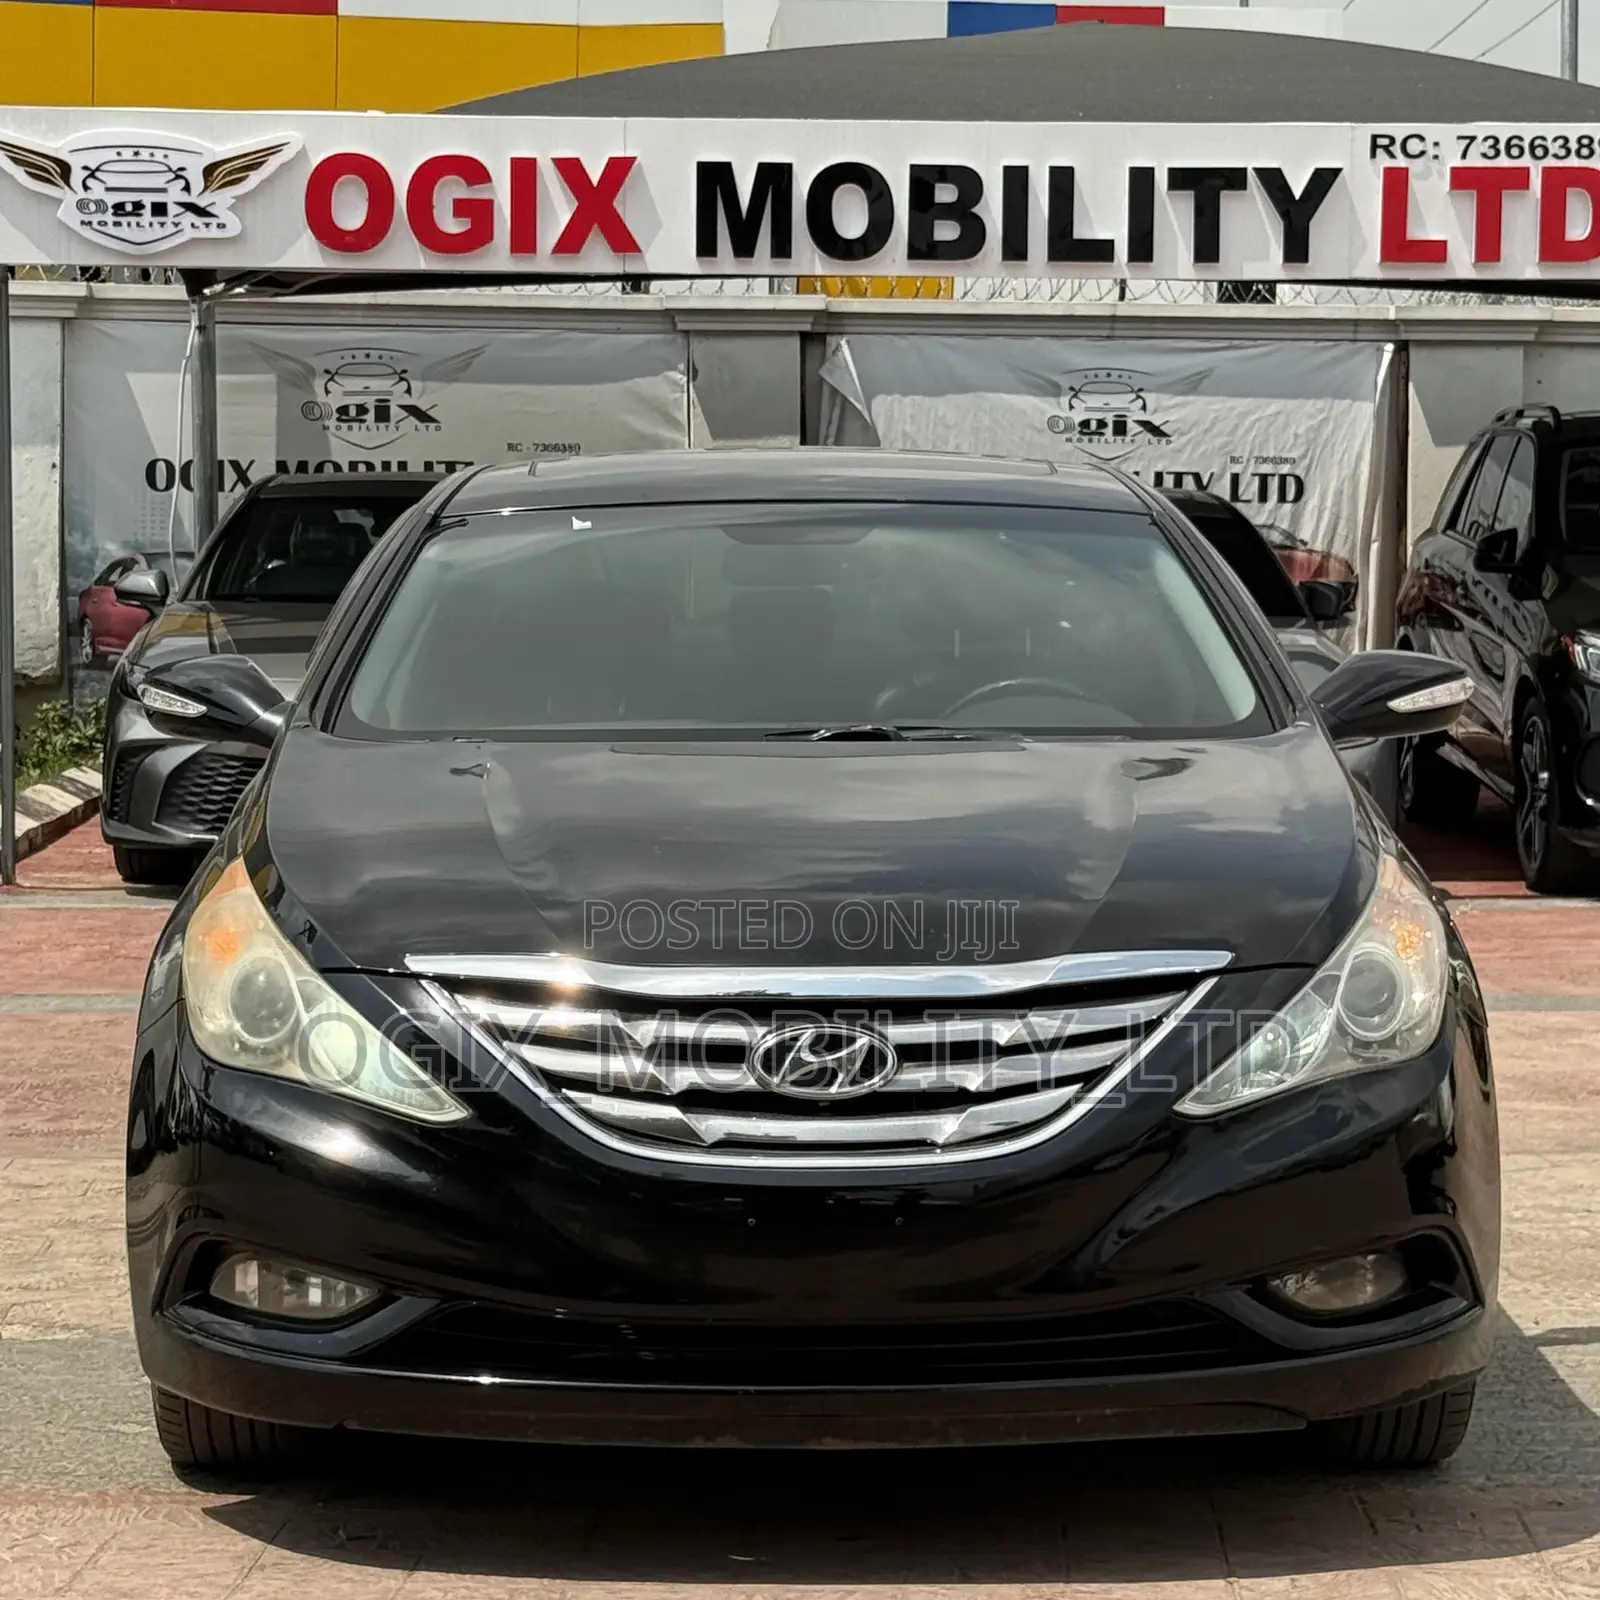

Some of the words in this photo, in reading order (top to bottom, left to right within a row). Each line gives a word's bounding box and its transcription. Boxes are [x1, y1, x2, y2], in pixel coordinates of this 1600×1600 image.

[1369, 133, 1440, 160] RC:
[1456, 134, 1600, 161] 736638
[304, 152, 642, 255] OGIX
[695, 160, 1343, 264] MOBILITY
[1380, 166, 1600, 265] LTD
[79, 219, 182, 229] MOBILITY
[190, 221, 227, 230] LTD
[322, 424, 401, 432] MOBILITY
[414, 424, 442, 432] LTD
[1065, 436, 1136, 445] MOBILITY
[506, 442, 523, 453] RC
[1229, 455, 1244, 465] RC
[1229, 472, 1304, 504] LTD
